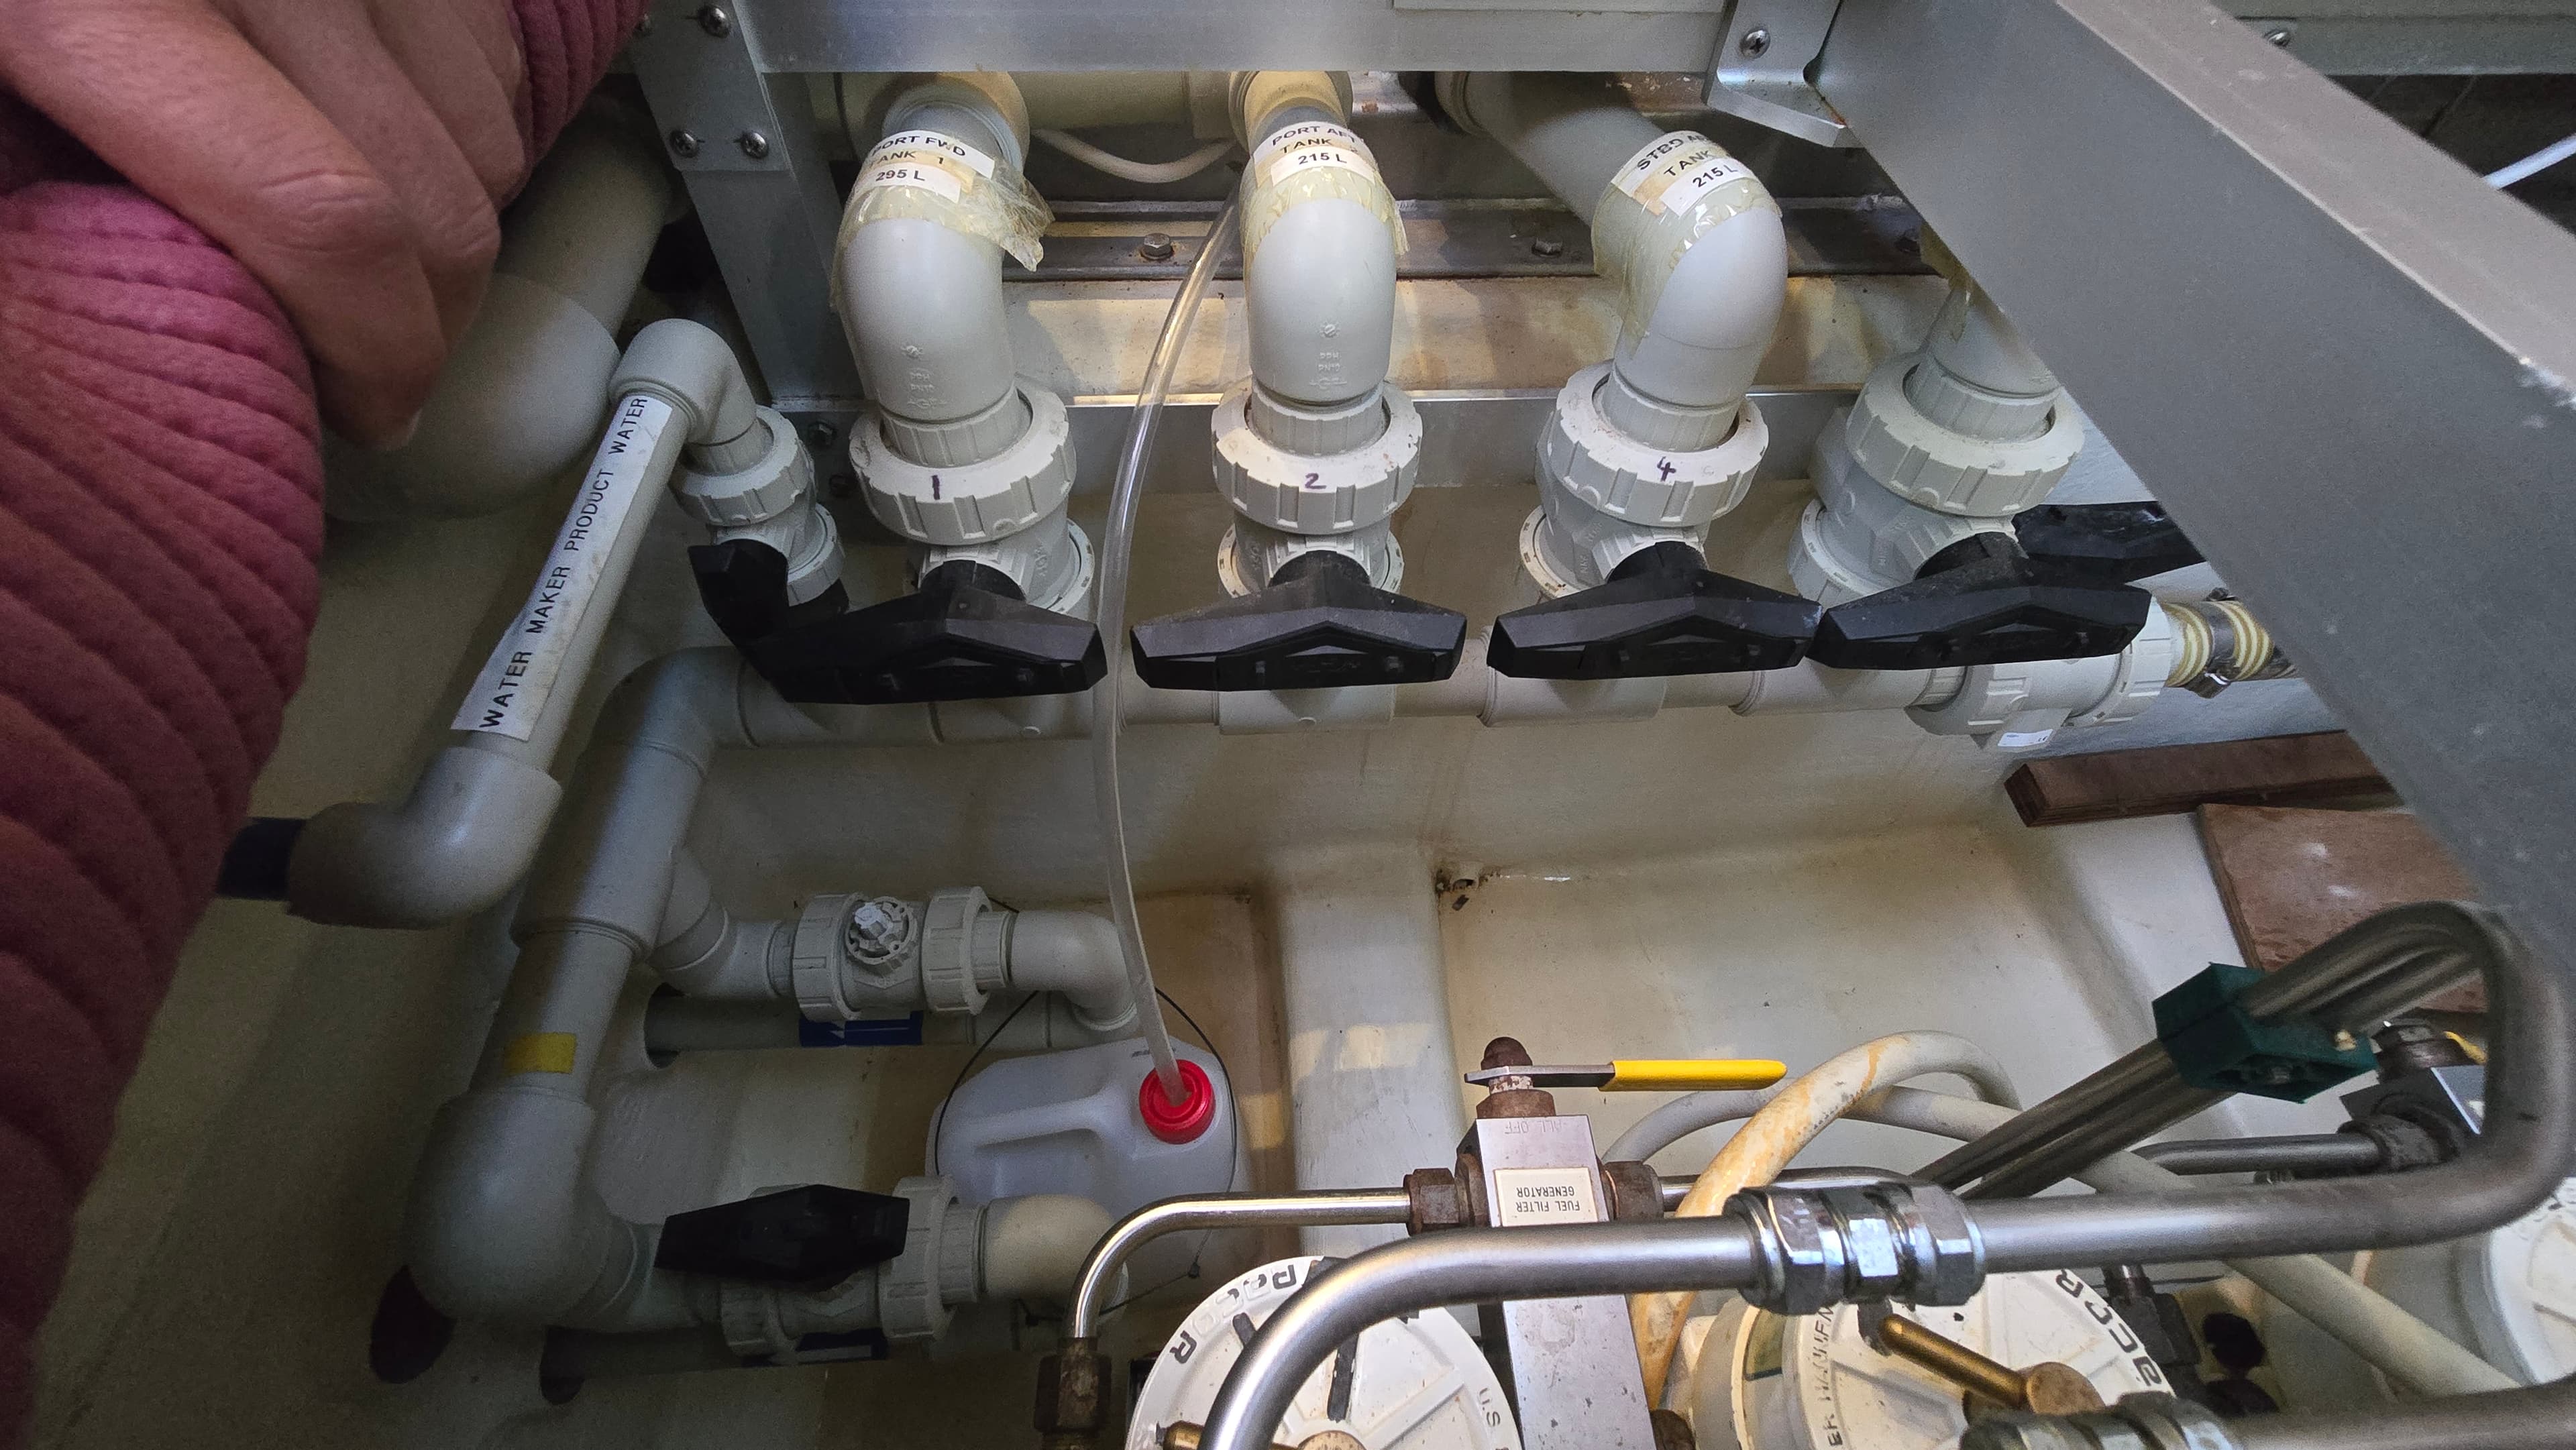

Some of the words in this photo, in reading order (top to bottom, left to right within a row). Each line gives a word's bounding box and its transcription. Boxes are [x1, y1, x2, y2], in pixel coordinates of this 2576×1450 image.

[1272, 125, 1321, 146] PORT
[1327, 128, 1356, 144] AFT
[872, 135, 920, 156] PORT
[1280, 138, 1333, 154] TANK
[1637, 138, 1684, 171] STBD
[937, 157, 944, 165] 1
[1298, 152, 1330, 165] 215
[1336, 154, 1348, 164] L
[1664, 150, 1713, 177] TANK
[875, 168, 908, 182] 295
[913, 170, 926, 181] L
[1693, 167, 1725, 188] 215
[1723, 164, 1739, 173] L
[1657, 456, 1676, 482] 4
[931, 474, 941, 500] 1
[1305, 472, 1327, 490] 2
[480, 650, 532, 728] WATER
[525, 566, 571, 634] MAKER
[564, 469, 614, 551] PRODUCT
[608, 397, 647, 455] WATER
[1516, 1185, 1575, 1198] GENERATOR
[1515, 1201, 1550, 1213] FILTER
[1555, 1200, 1580, 1212] FUEL
